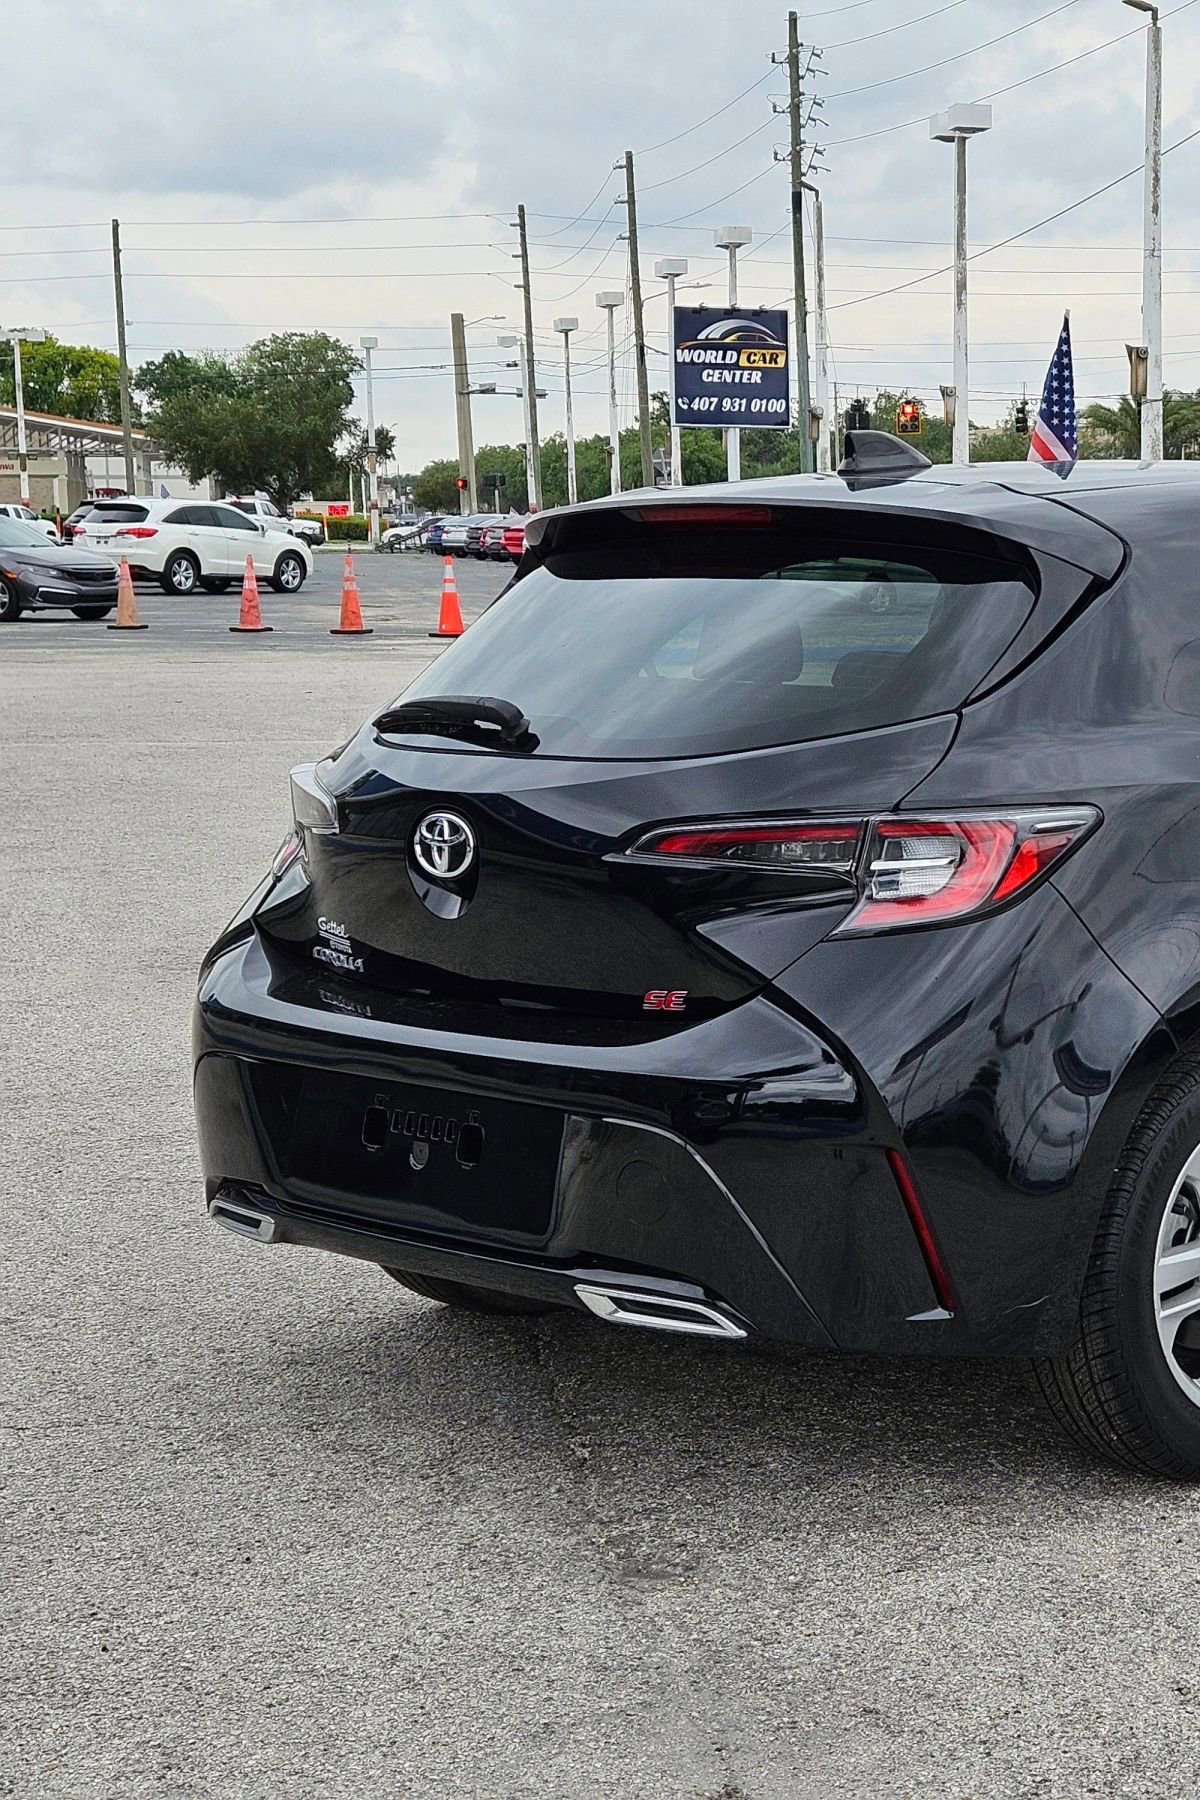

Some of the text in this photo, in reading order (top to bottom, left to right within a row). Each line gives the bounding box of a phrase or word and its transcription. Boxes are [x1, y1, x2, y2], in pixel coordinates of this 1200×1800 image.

[676, 349, 780, 365] WORLD CAR
[702, 369, 762, 384] CENTER
[690, 397, 786, 413] 407 931 0100
[318, 917, 349, 938] Gettel
[313, 946, 364, 973] COROLLA
[643, 990, 688, 1010] SE
